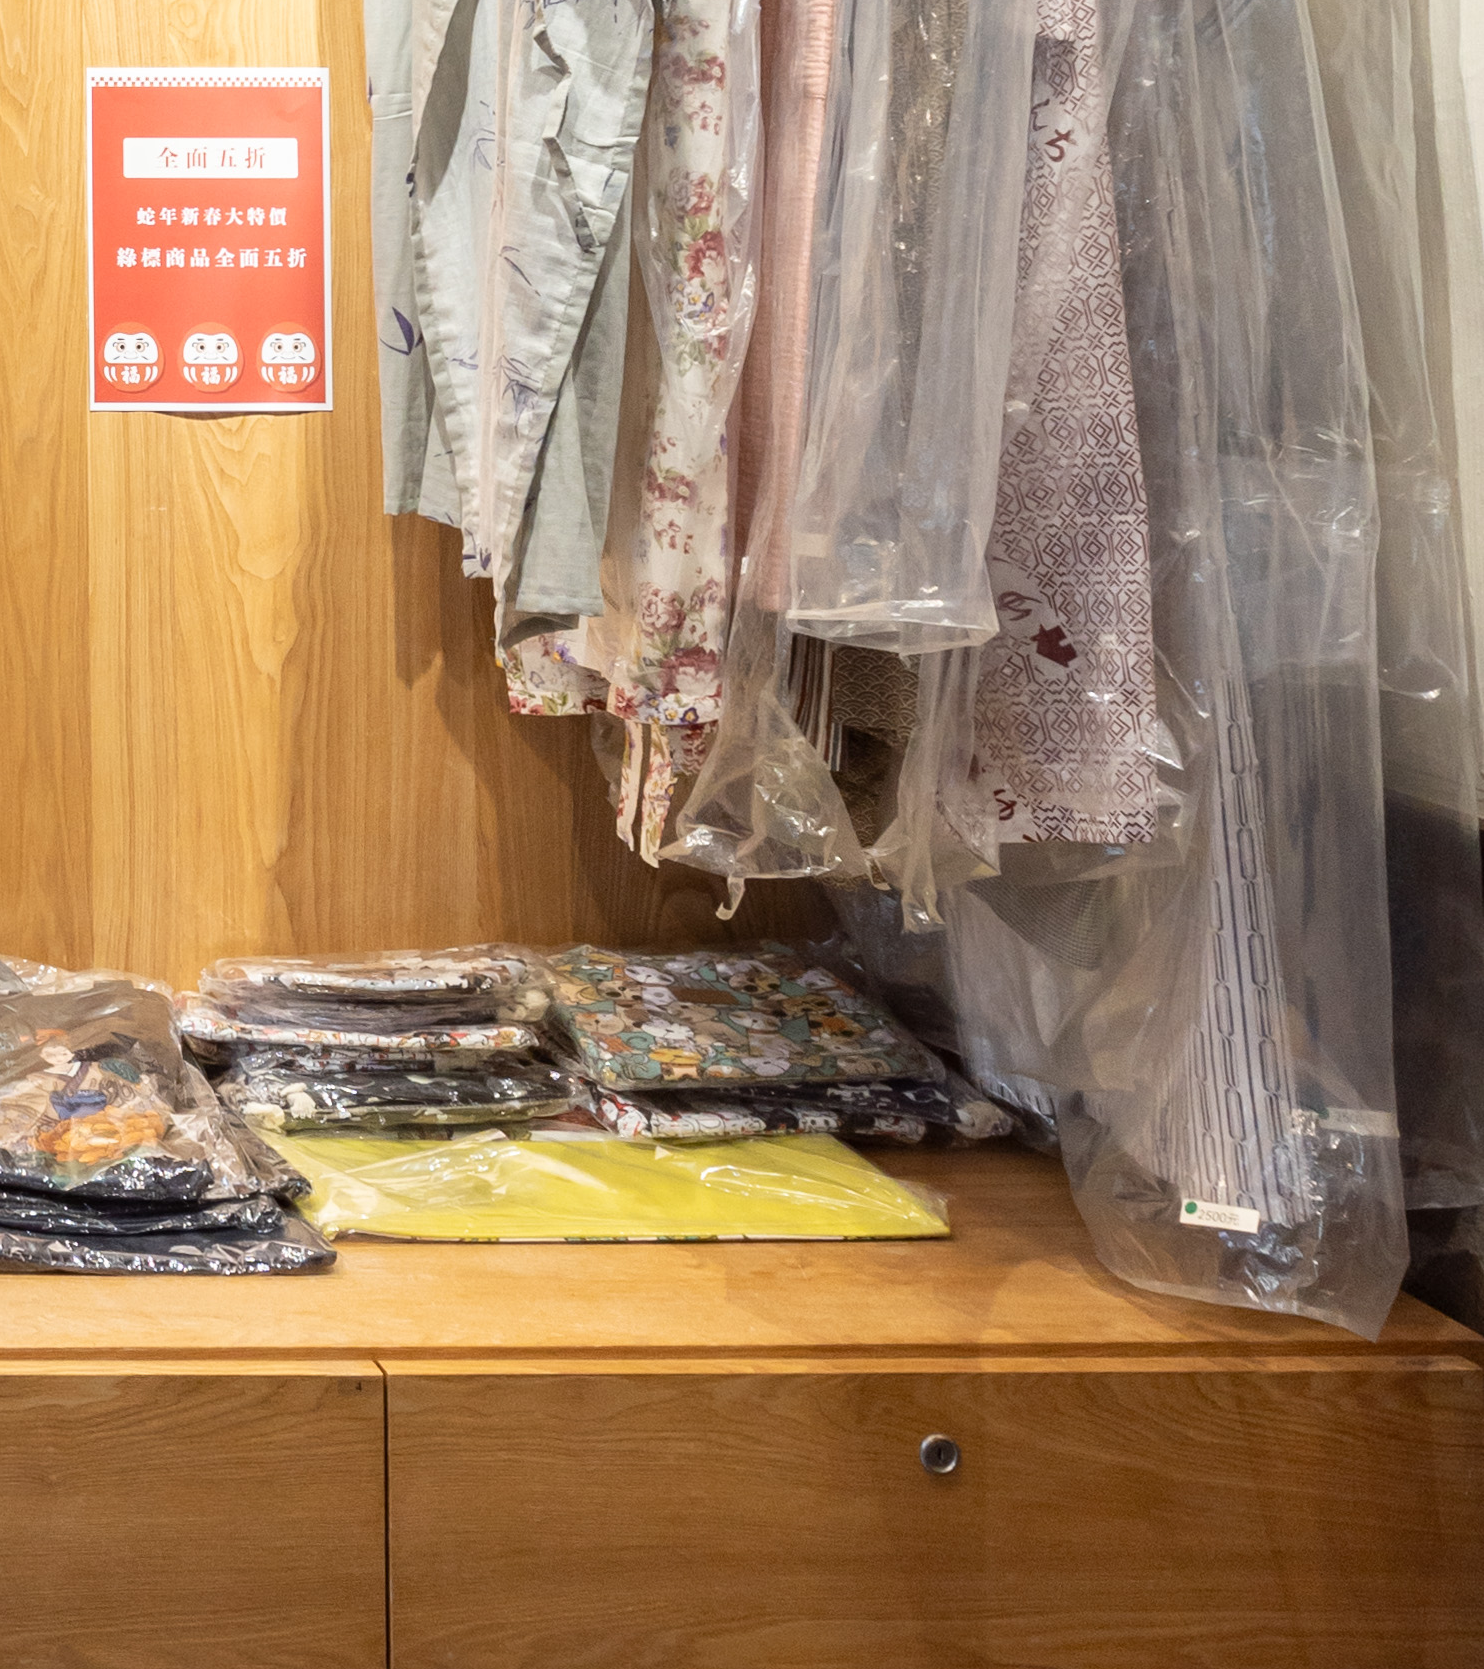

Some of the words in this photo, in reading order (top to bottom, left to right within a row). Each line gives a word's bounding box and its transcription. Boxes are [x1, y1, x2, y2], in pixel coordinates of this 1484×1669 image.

[156, 146, 267, 169] 全面五折
[136, 207, 287, 226] 蛇年新春大特價
[116, 247, 307, 268] 綠標商品全面五折
[121, 365, 141, 385] 福
[200, 365, 221, 385] 福
[278, 365, 298, 385] 福
[1197, 1209, 1240, 1227] 2500元
